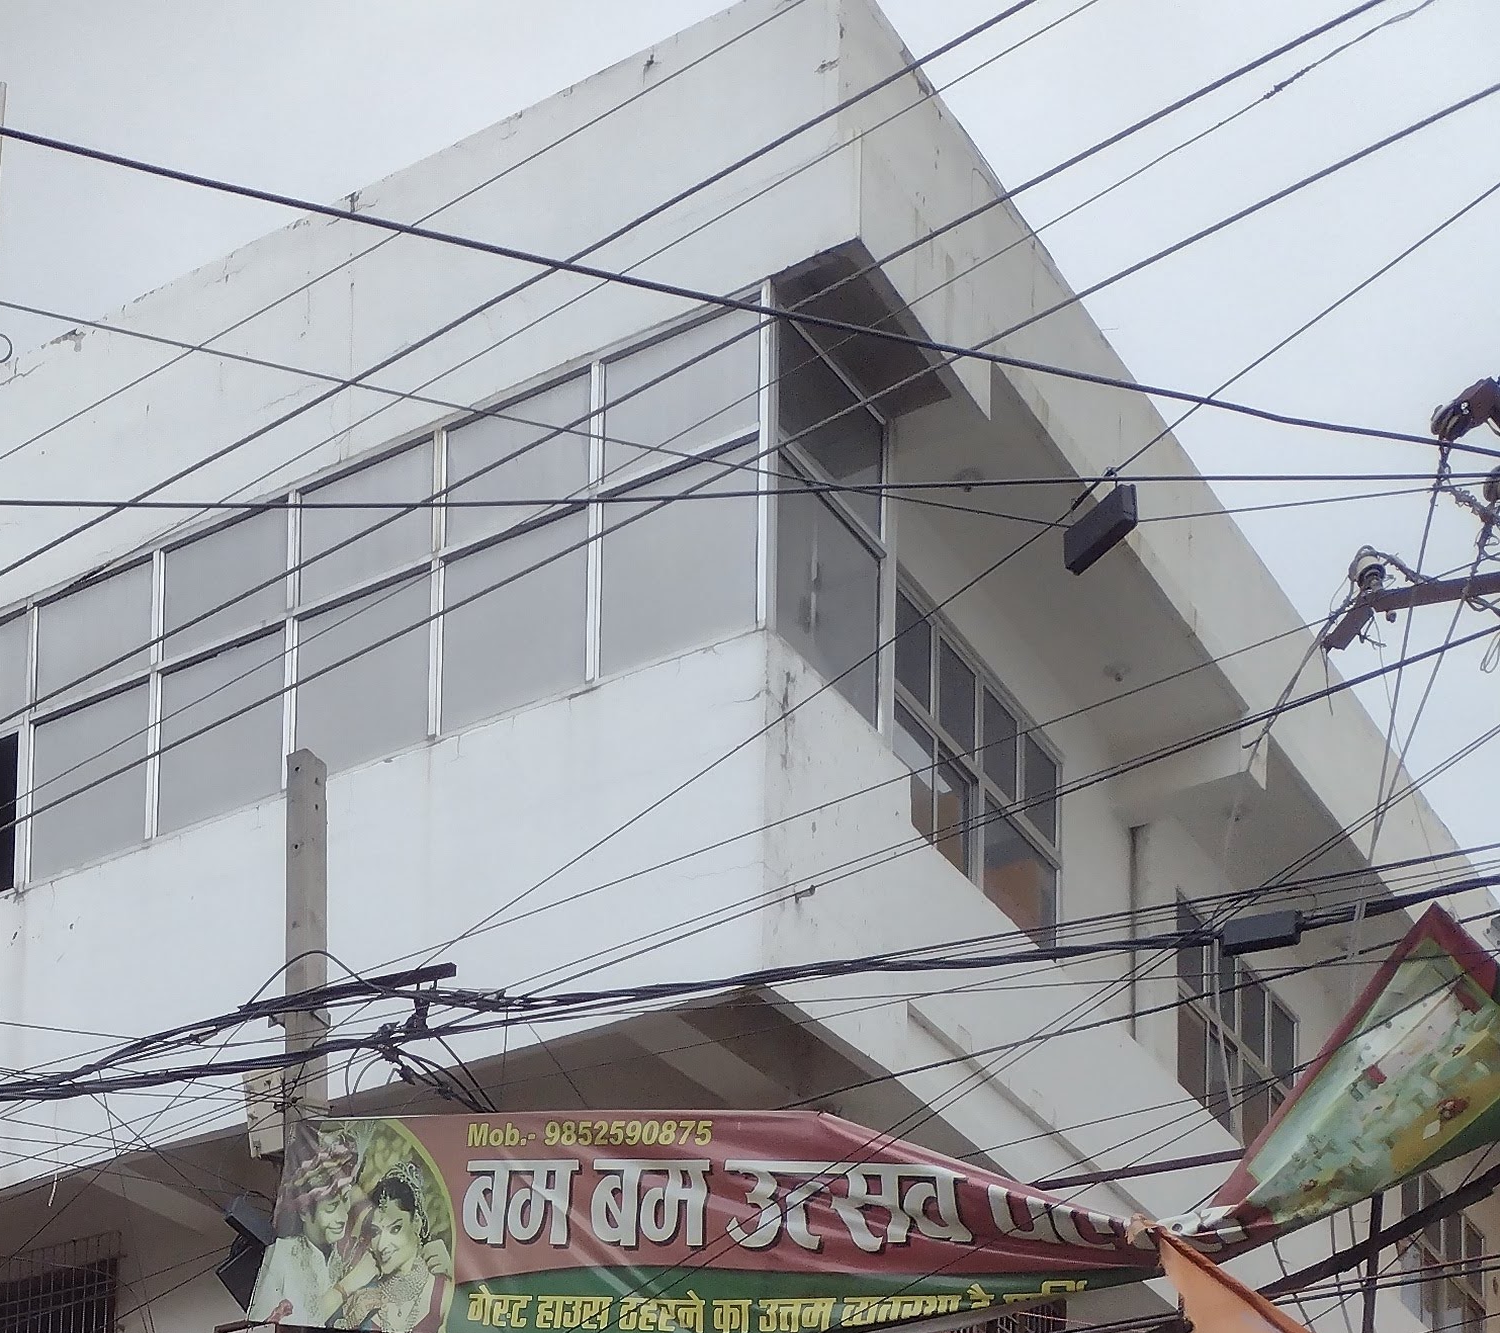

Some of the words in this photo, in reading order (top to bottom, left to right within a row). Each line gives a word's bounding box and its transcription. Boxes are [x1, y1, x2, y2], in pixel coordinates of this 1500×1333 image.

[467, 1123, 535, 1147] Mob.-
[544, 1120, 713, 1146] 9852590875
[462, 1159, 580, 1245] बम
[591, 1158, 711, 1247] बम
[724, 1158, 973, 1253] उत्सव
[536, 1295, 614, 1330] हाउस
[713, 1299, 753, 1333] का
[758, 1297, 837, 1333] उत्तम
